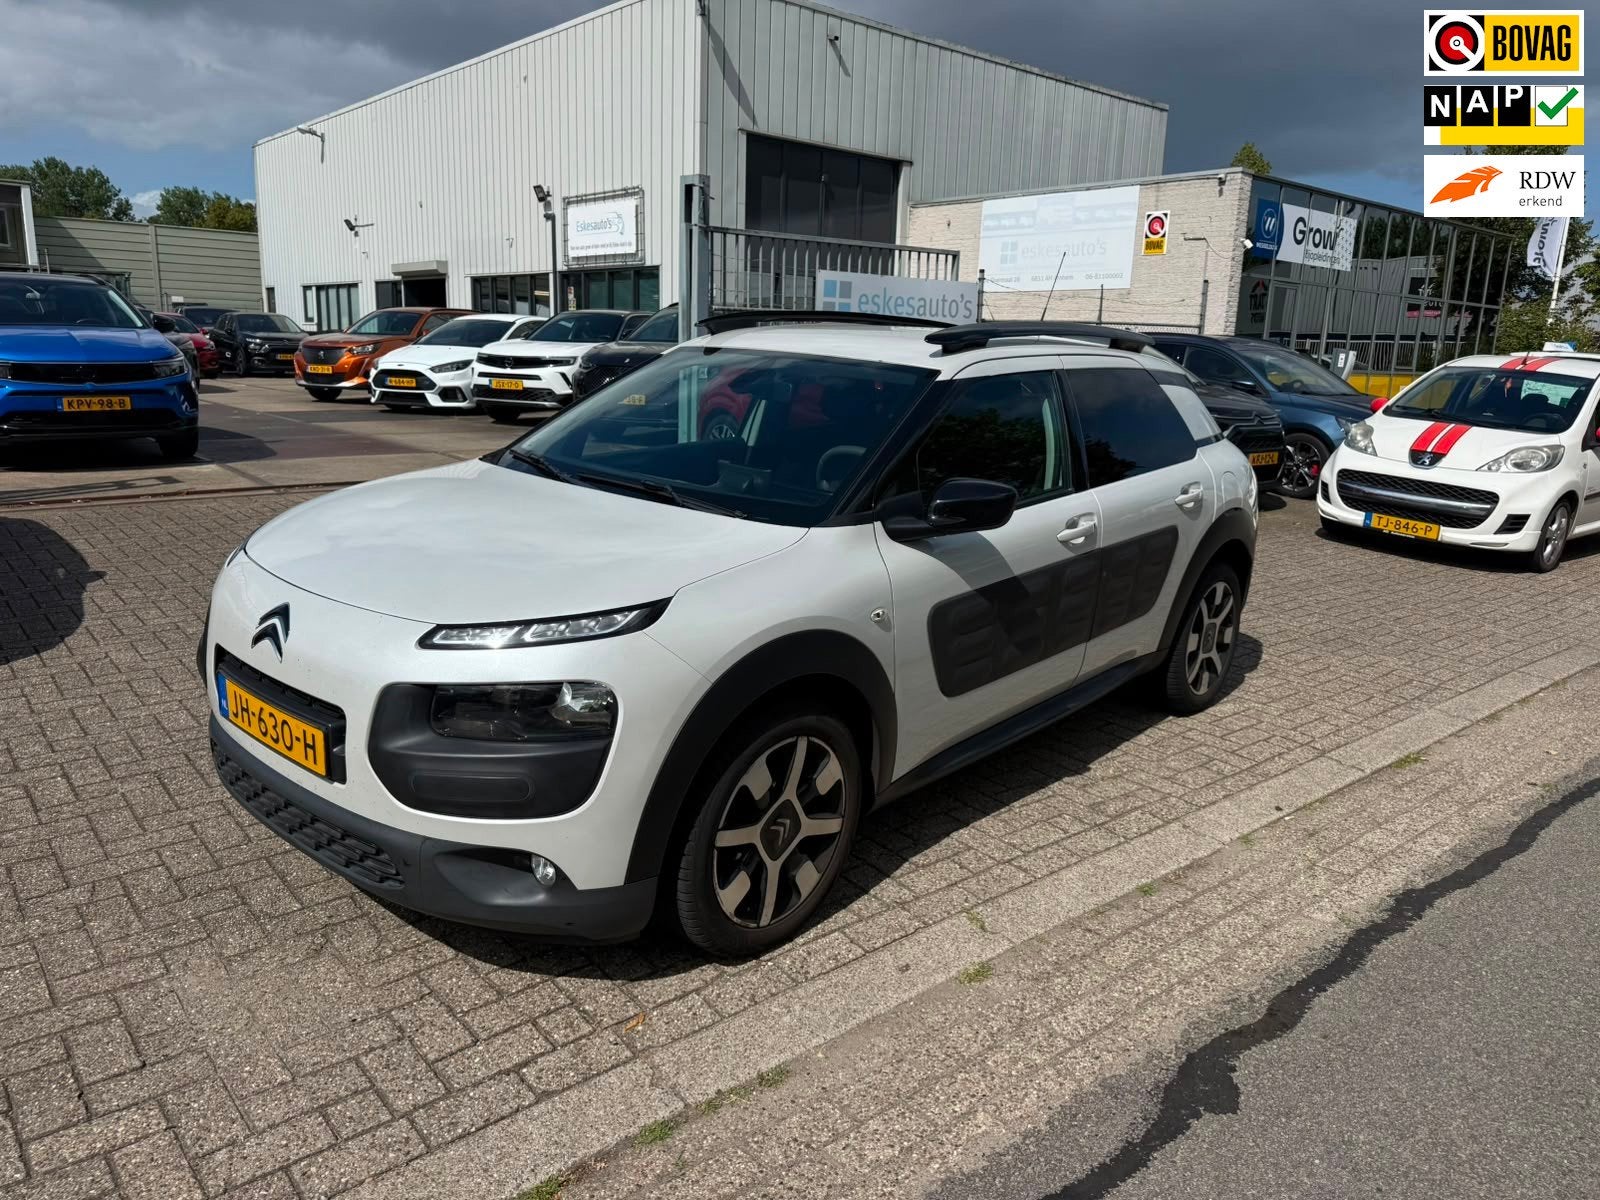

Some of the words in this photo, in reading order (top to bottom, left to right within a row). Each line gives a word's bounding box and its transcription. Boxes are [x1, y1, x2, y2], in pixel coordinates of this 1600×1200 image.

[576, 217, 612, 233] Eskesauto's
[1021, 238, 1107, 259] eskesauto's
[1145, 239, 1164, 251] BOVAG
[857, 287, 973, 320] eskesauto's
[67, 399, 126, 410] KPV-98-B
[1376, 516, 1433, 535] TJ-846-P
[232, 690, 319, 766] JH-630-H
